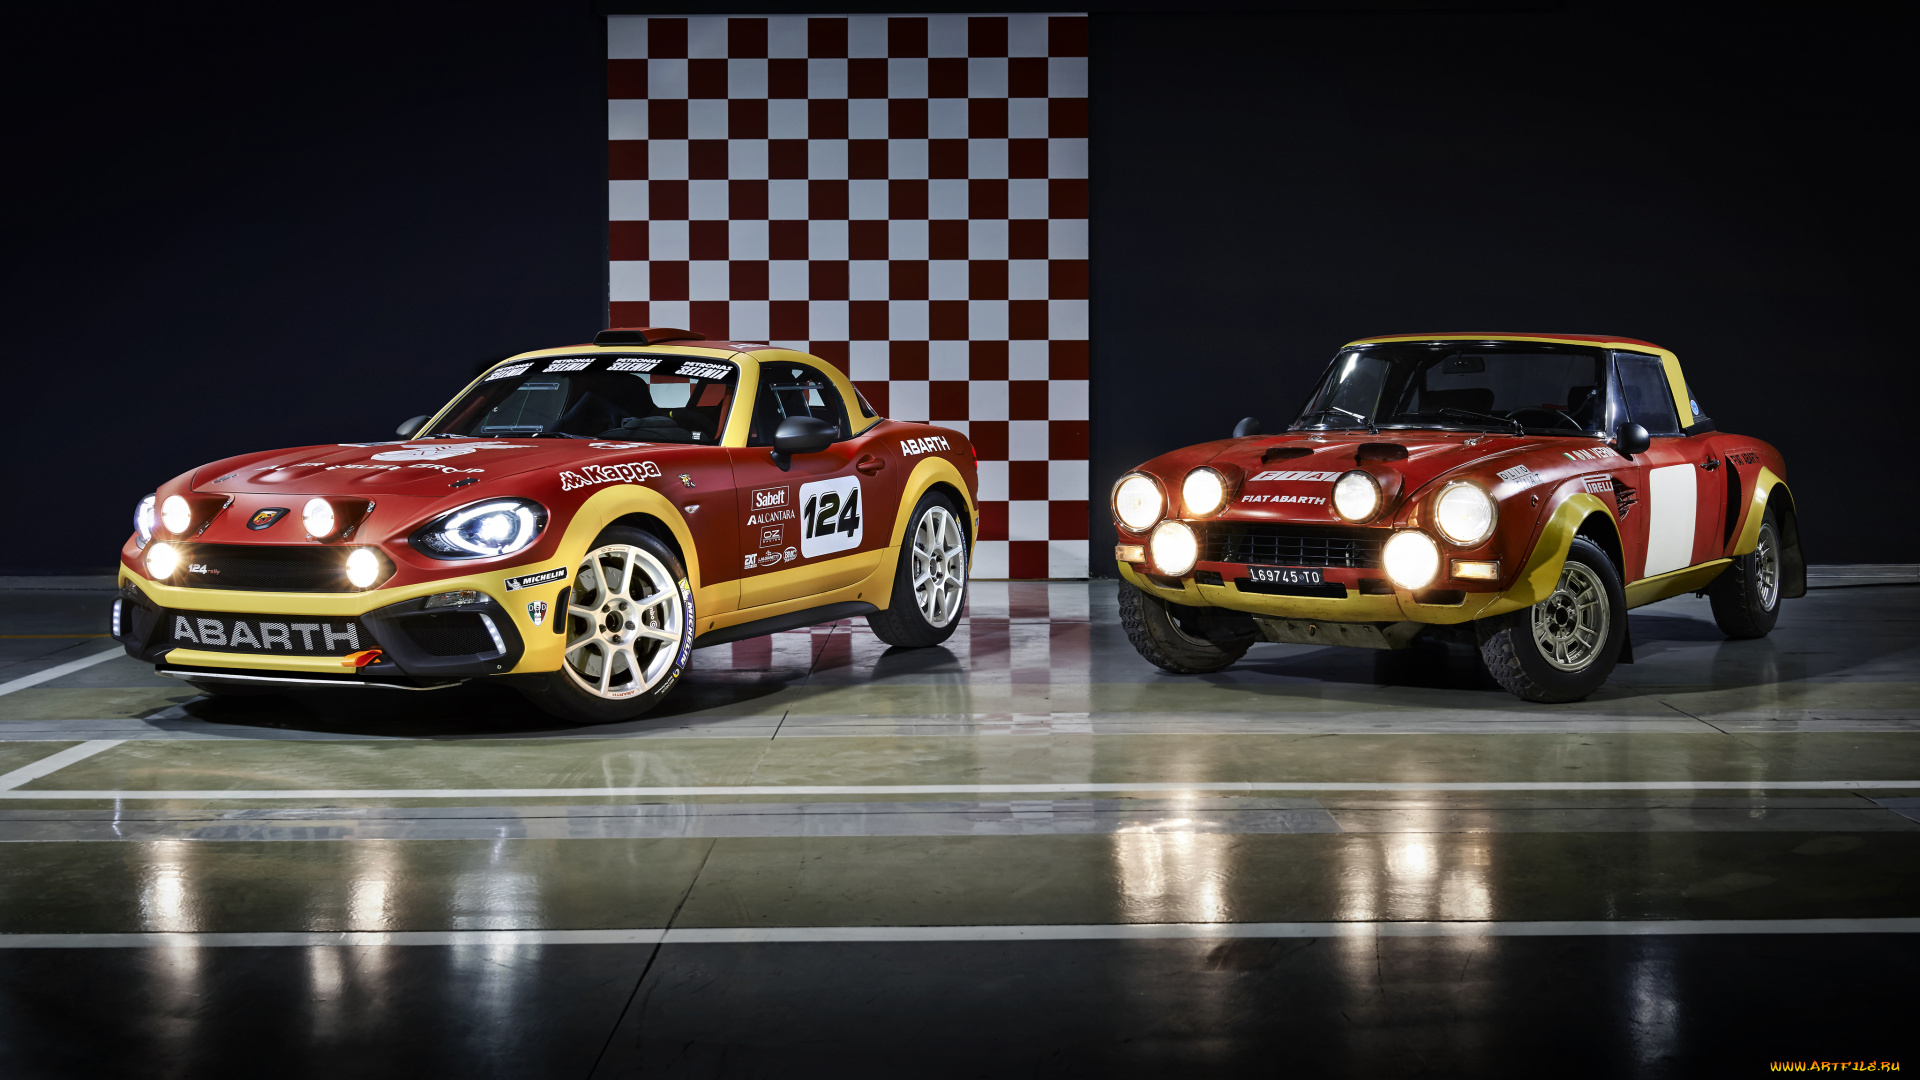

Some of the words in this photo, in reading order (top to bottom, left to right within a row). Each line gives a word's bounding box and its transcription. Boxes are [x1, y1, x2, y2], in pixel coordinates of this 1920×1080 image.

[541, 362, 592, 373] SELENIA
[605, 362, 659, 373] SELENIA
[675, 365, 730, 380] SELENIA
[684, 361, 734, 371] PETRONAS
[900, 436, 951, 457] ABARTH
[582, 461, 661, 483] Kappa
[1580, 473, 1615, 494] PIRELLI
[756, 490, 785, 508] Sabelt
[1241, 495, 1271, 503] FIAT
[1270, 495, 1327, 505] ABARTH
[757, 509, 796, 525] ALCANTARA
[803, 487, 860, 539] 124
[188, 563, 208, 575] 124
[1250, 568, 1298, 583] L69745
[1303, 571, 1320, 584] TO
[523, 570, 565, 585] MICHELIN
[174, 615, 360, 652] ABARTH
[681, 601, 693, 667] MICHELIN
